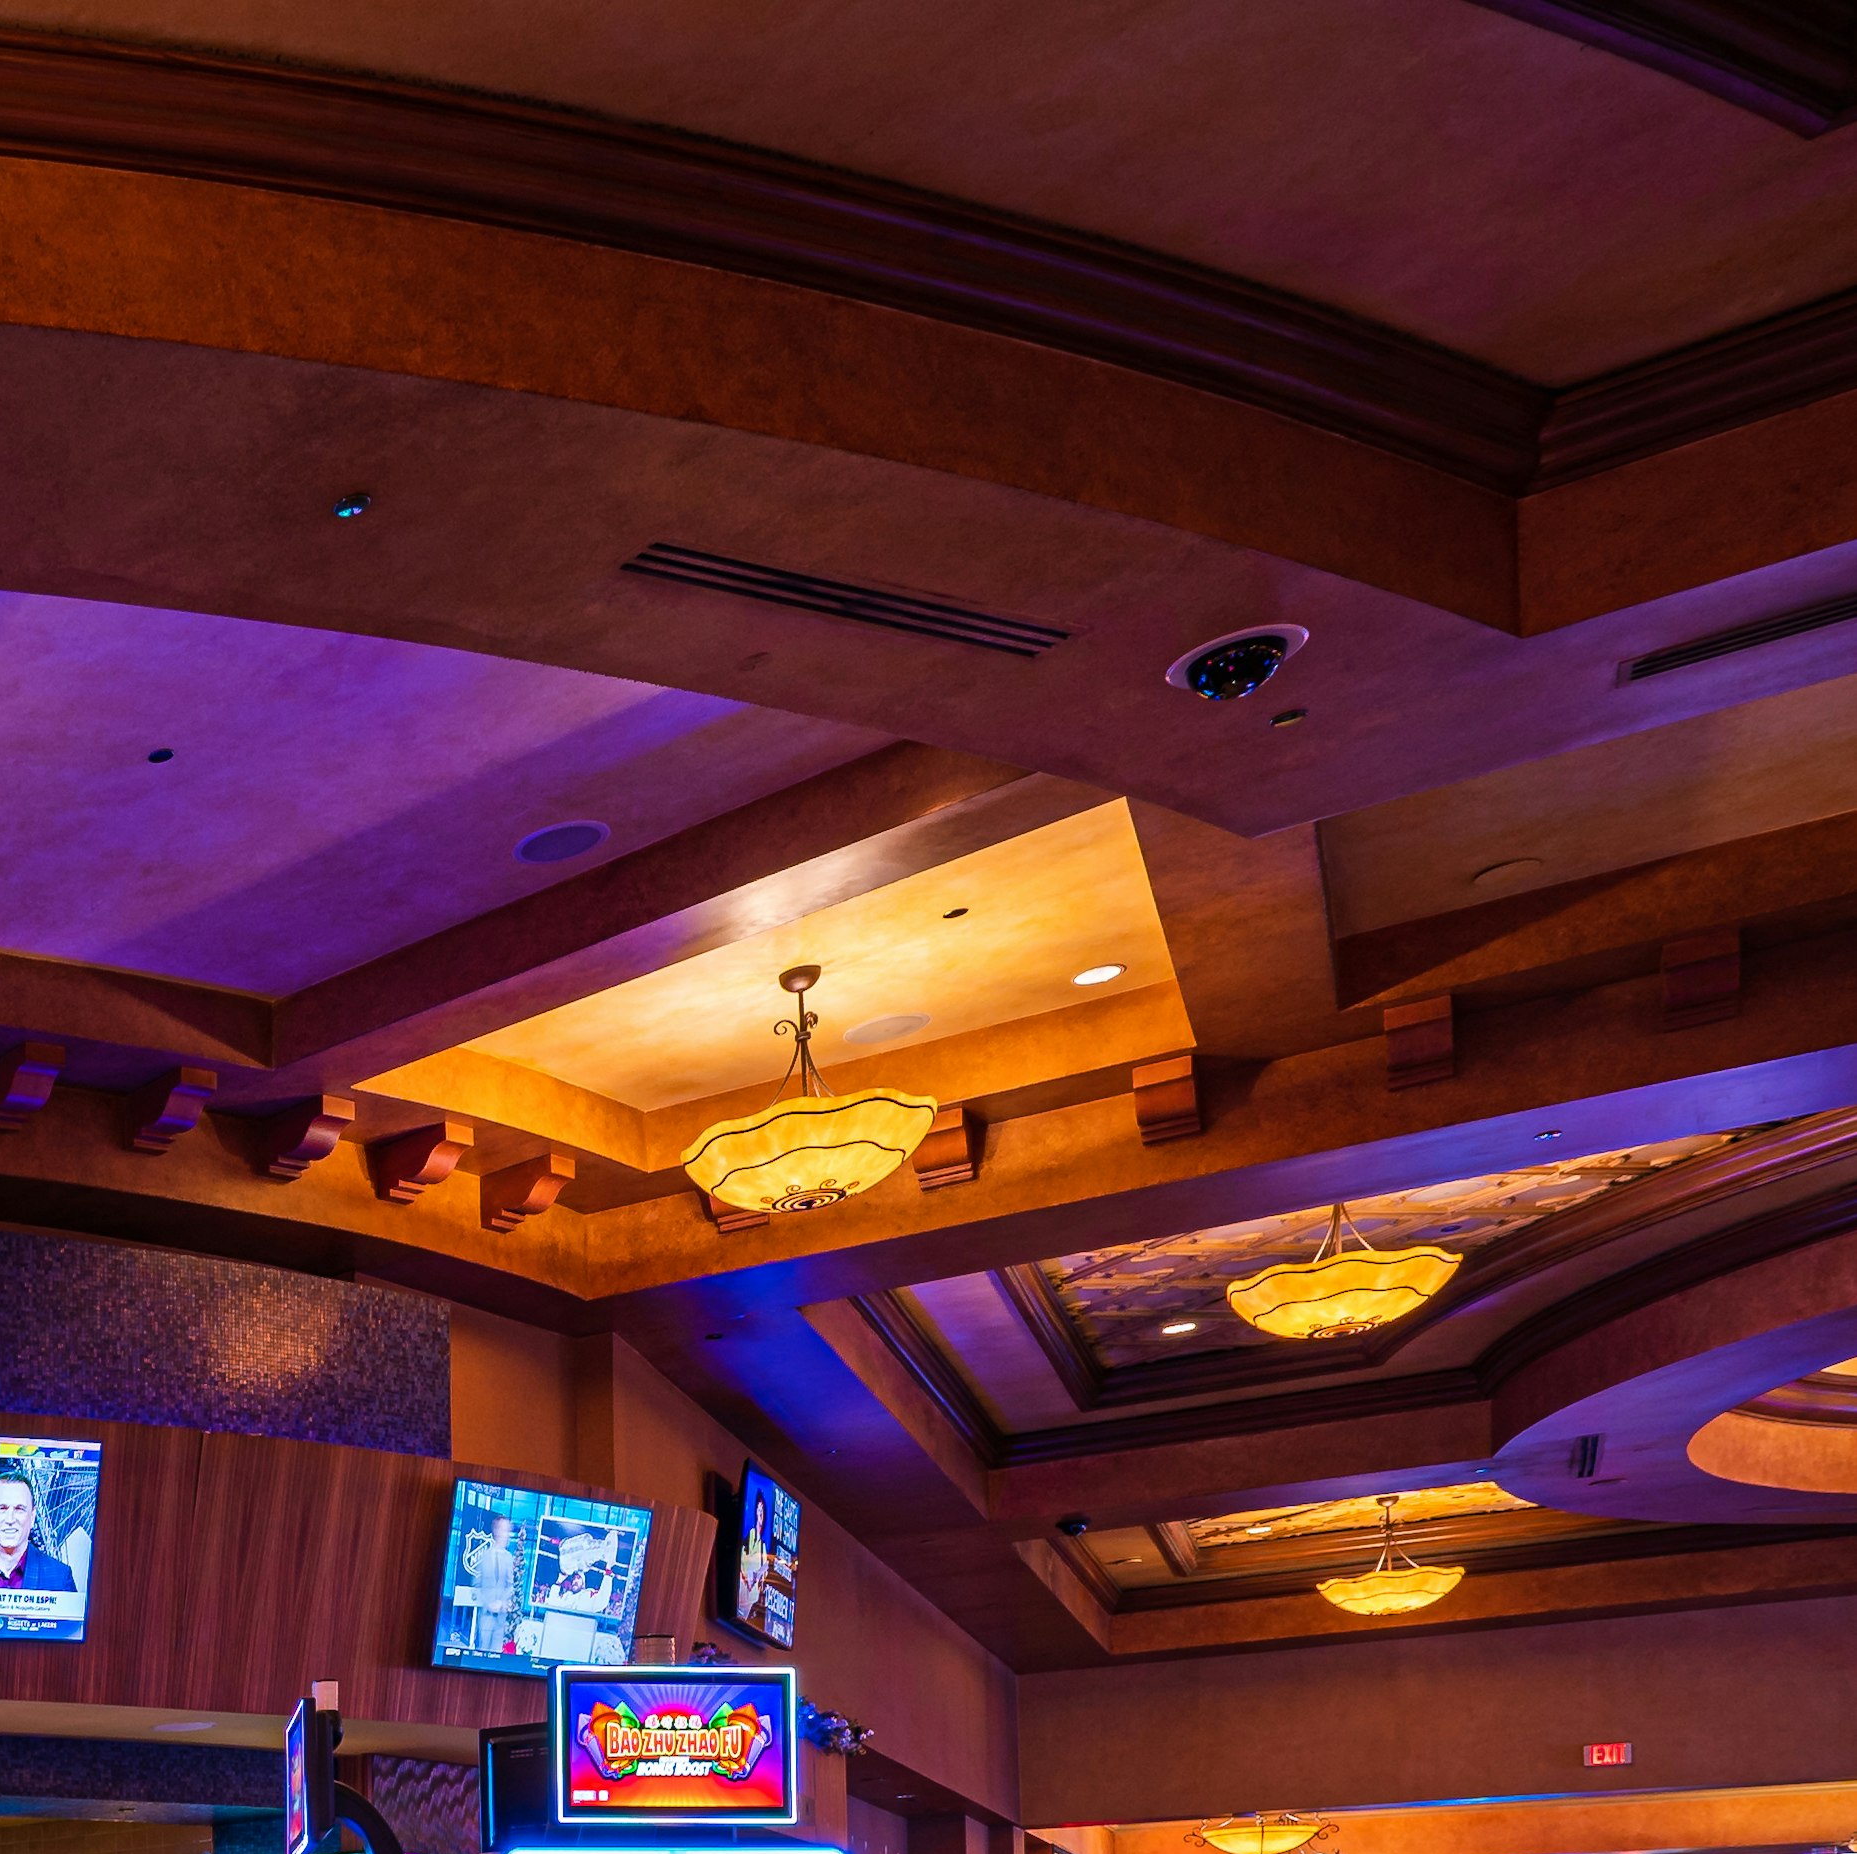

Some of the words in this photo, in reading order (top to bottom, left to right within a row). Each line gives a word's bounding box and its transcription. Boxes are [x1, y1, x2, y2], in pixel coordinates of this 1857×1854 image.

[13, 1594, 23, 1603] ET
[23, 1595, 34, 1603] ON
[606, 1722, 642, 1758] BAO
[642, 1729, 675, 1757] ZHU
[676, 1728, 720, 1758] ZHAO
[721, 1725, 742, 1759] FU
[1592, 1743, 1627, 1765] EXIT
[636, 1761, 676, 1776] BONUS
[674, 1761, 712, 1776] BOOST
